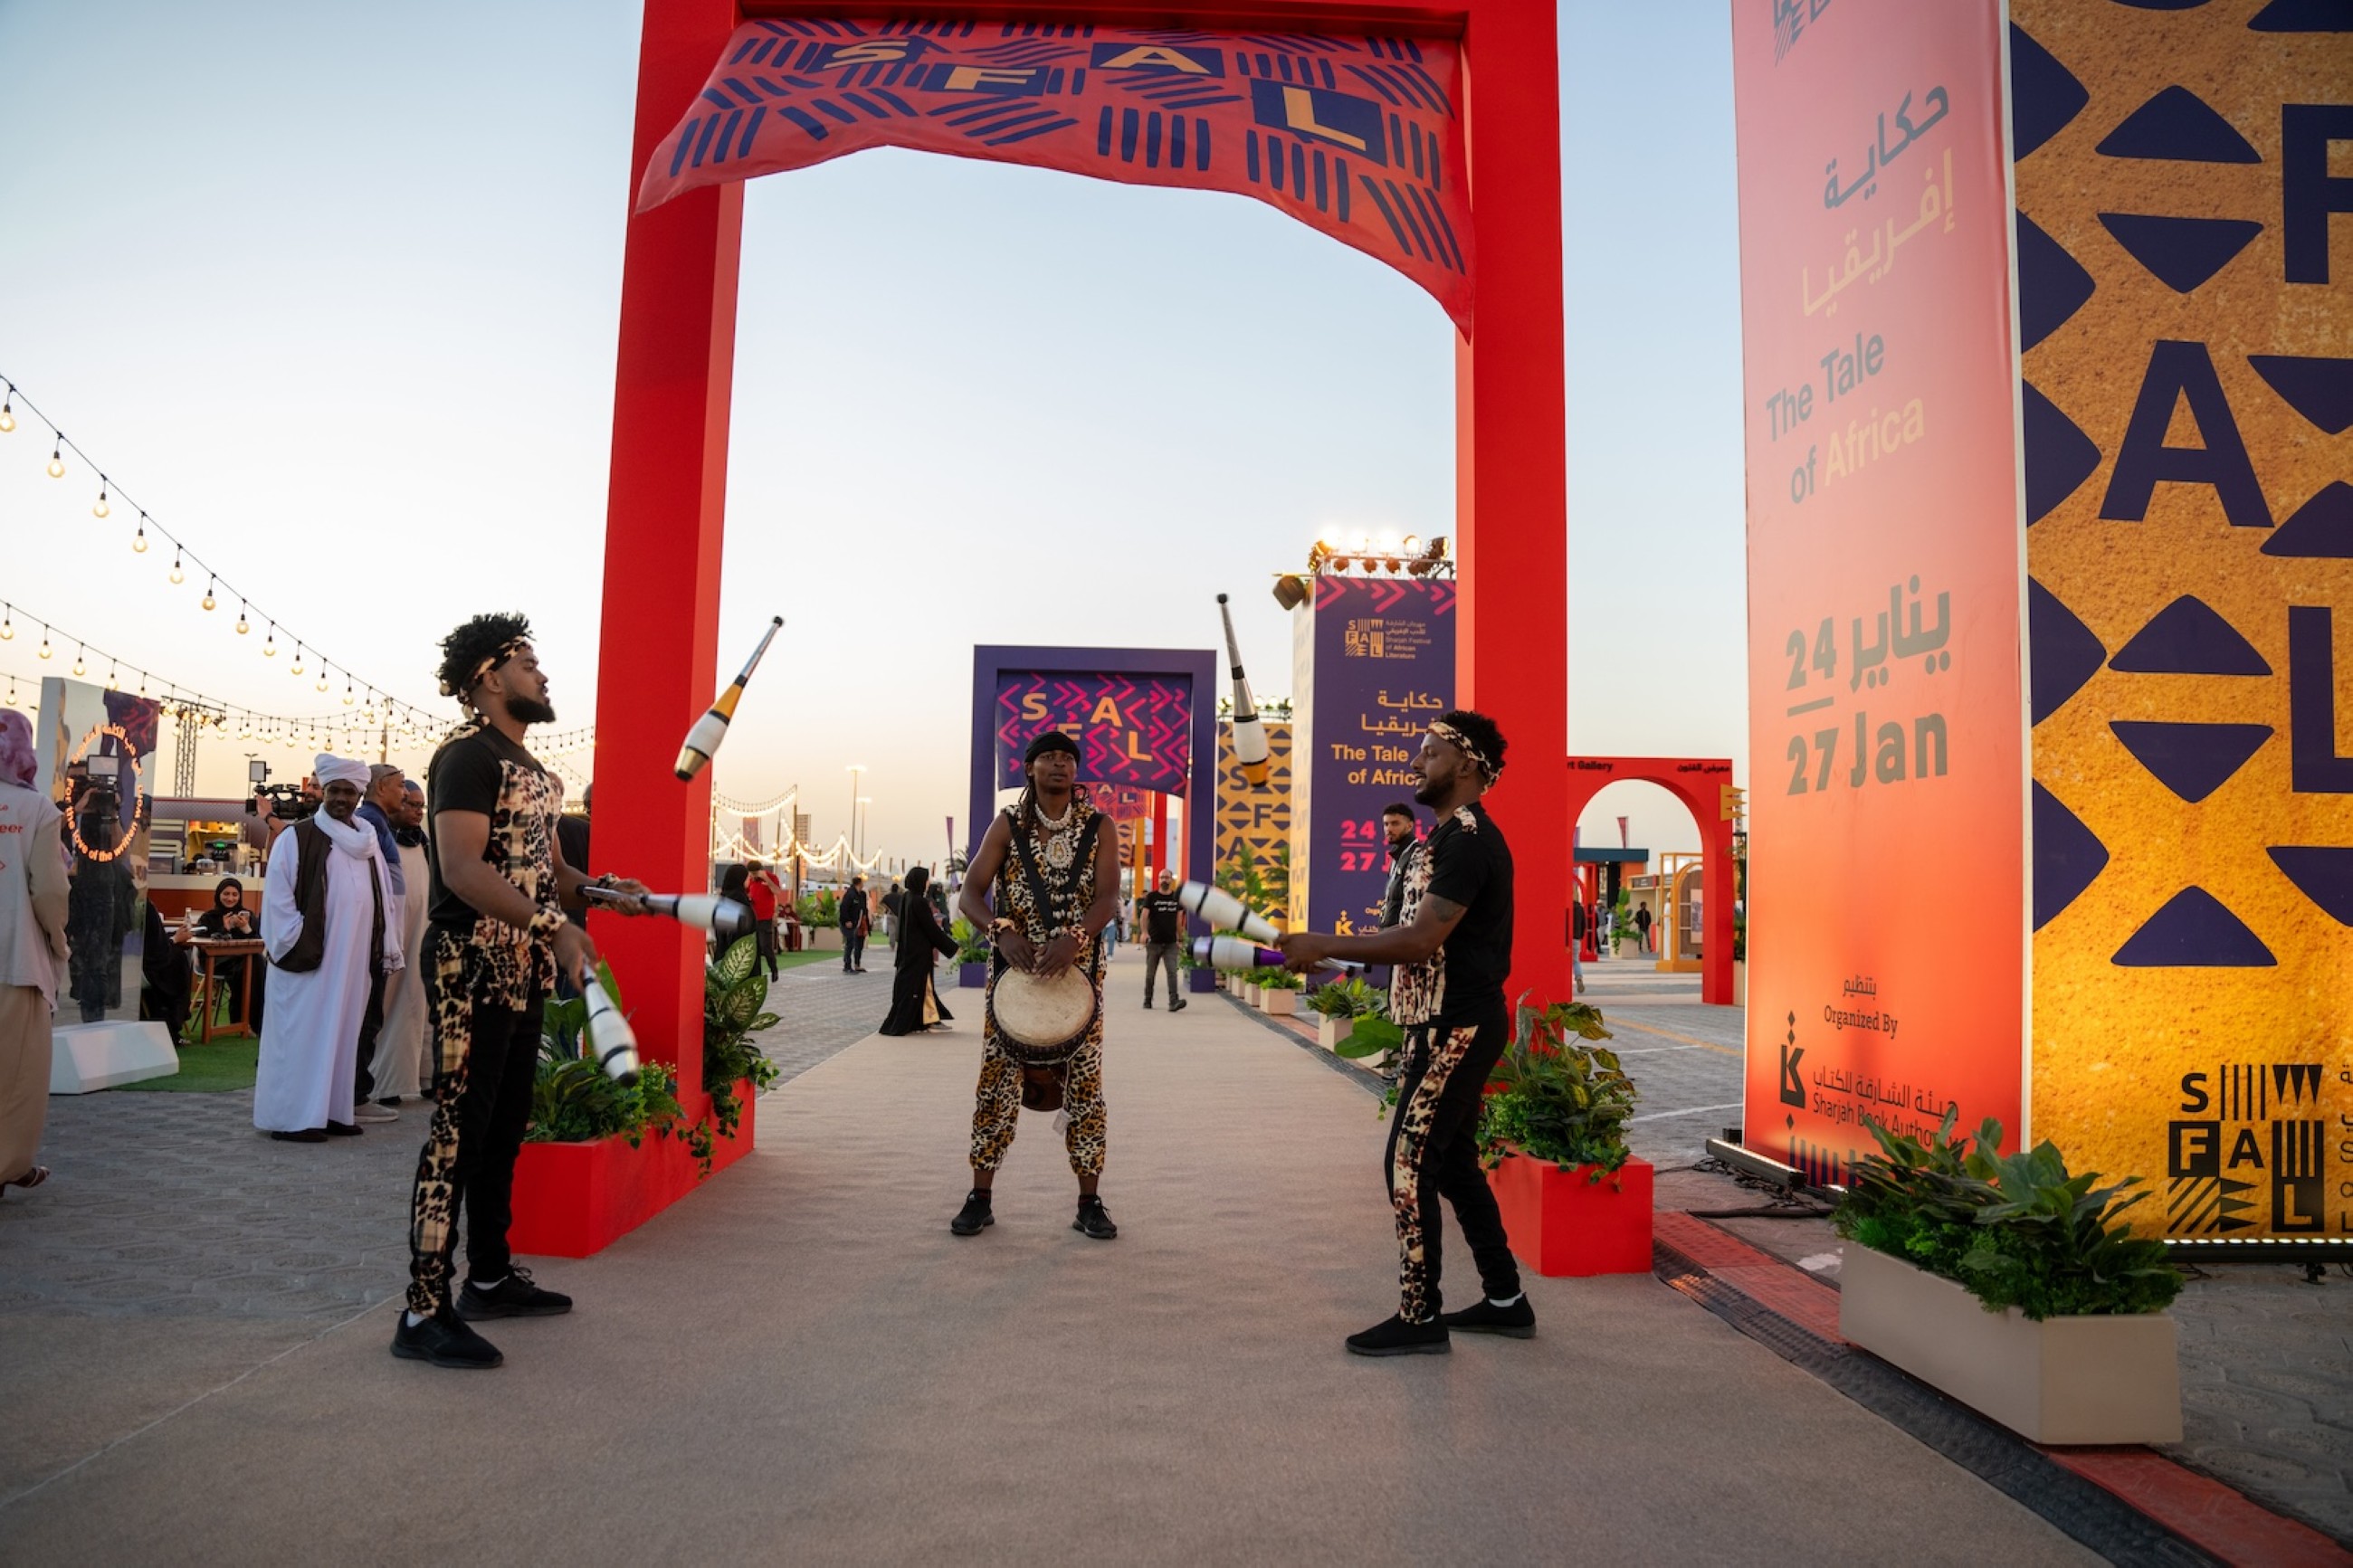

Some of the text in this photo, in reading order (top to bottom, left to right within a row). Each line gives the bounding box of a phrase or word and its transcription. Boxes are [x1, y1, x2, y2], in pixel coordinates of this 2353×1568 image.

[1824, 86, 1948, 209] حكاية
[1803, 147, 1955, 318] إفريقيا
[1766, 332, 1884, 442] The Tale
[1791, 398, 1924, 504] of Africa
[1786, 575, 1950, 694] يناير 24
[1377, 689, 1443, 713] حكاية
[1361, 713, 1434, 737] ريقيا
[1331, 744, 1409, 762] The Tale
[1577, 761, 1614, 773] Gallery
[1786, 711, 1948, 796] 27 Jan
[1348, 768, 1416, 785] of Afric
[1340, 819, 1377, 840] 24
[88, 850, 99, 861] of
[99, 850, 113, 862] the
[1339, 851, 1377, 871] 27
[1824, 1004, 1899, 1040] Organized By
[1813, 1066, 1853, 1094] للكتاب
[1855, 1075, 1910, 1108] الشارقة
[1813, 1092, 1854, 1125] Sharjah
